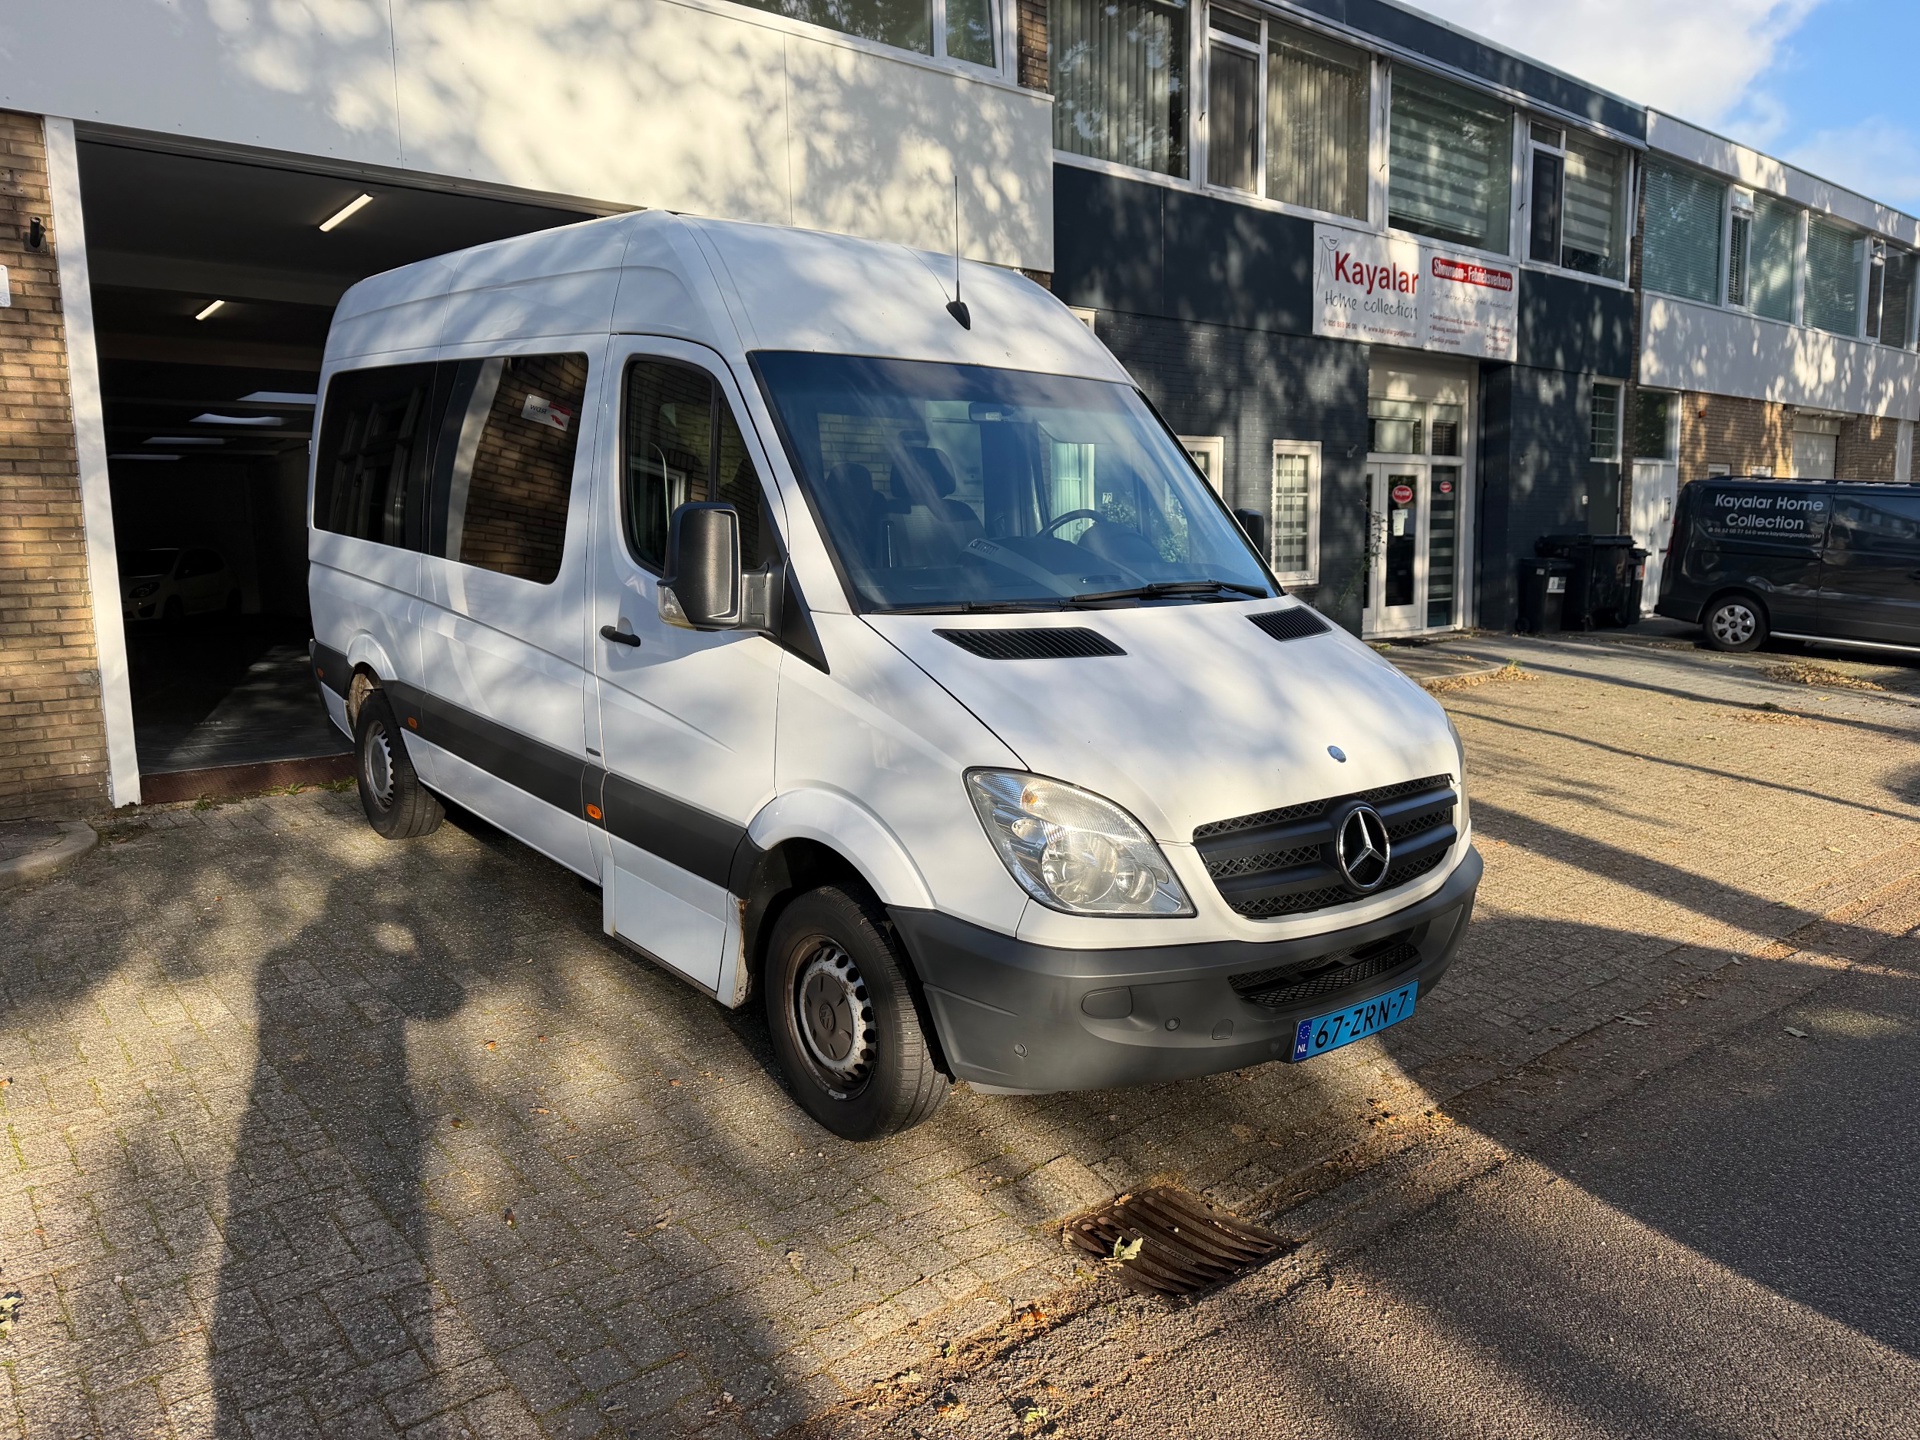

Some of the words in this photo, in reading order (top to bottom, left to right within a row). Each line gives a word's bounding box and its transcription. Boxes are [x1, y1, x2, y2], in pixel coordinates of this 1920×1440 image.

[1335, 251, 1419, 294] Kayalar
[1325, 290, 1357, 310] Home
[1364, 298, 1418, 320] collection
[1715, 494, 1773, 510] Kayalar
[1776, 496, 1824, 511] Home
[1726, 513, 1804, 530] Collection
[1315, 990, 1409, 1049] 67-ZRN-7
[1297, 1043, 1307, 1054] NL
